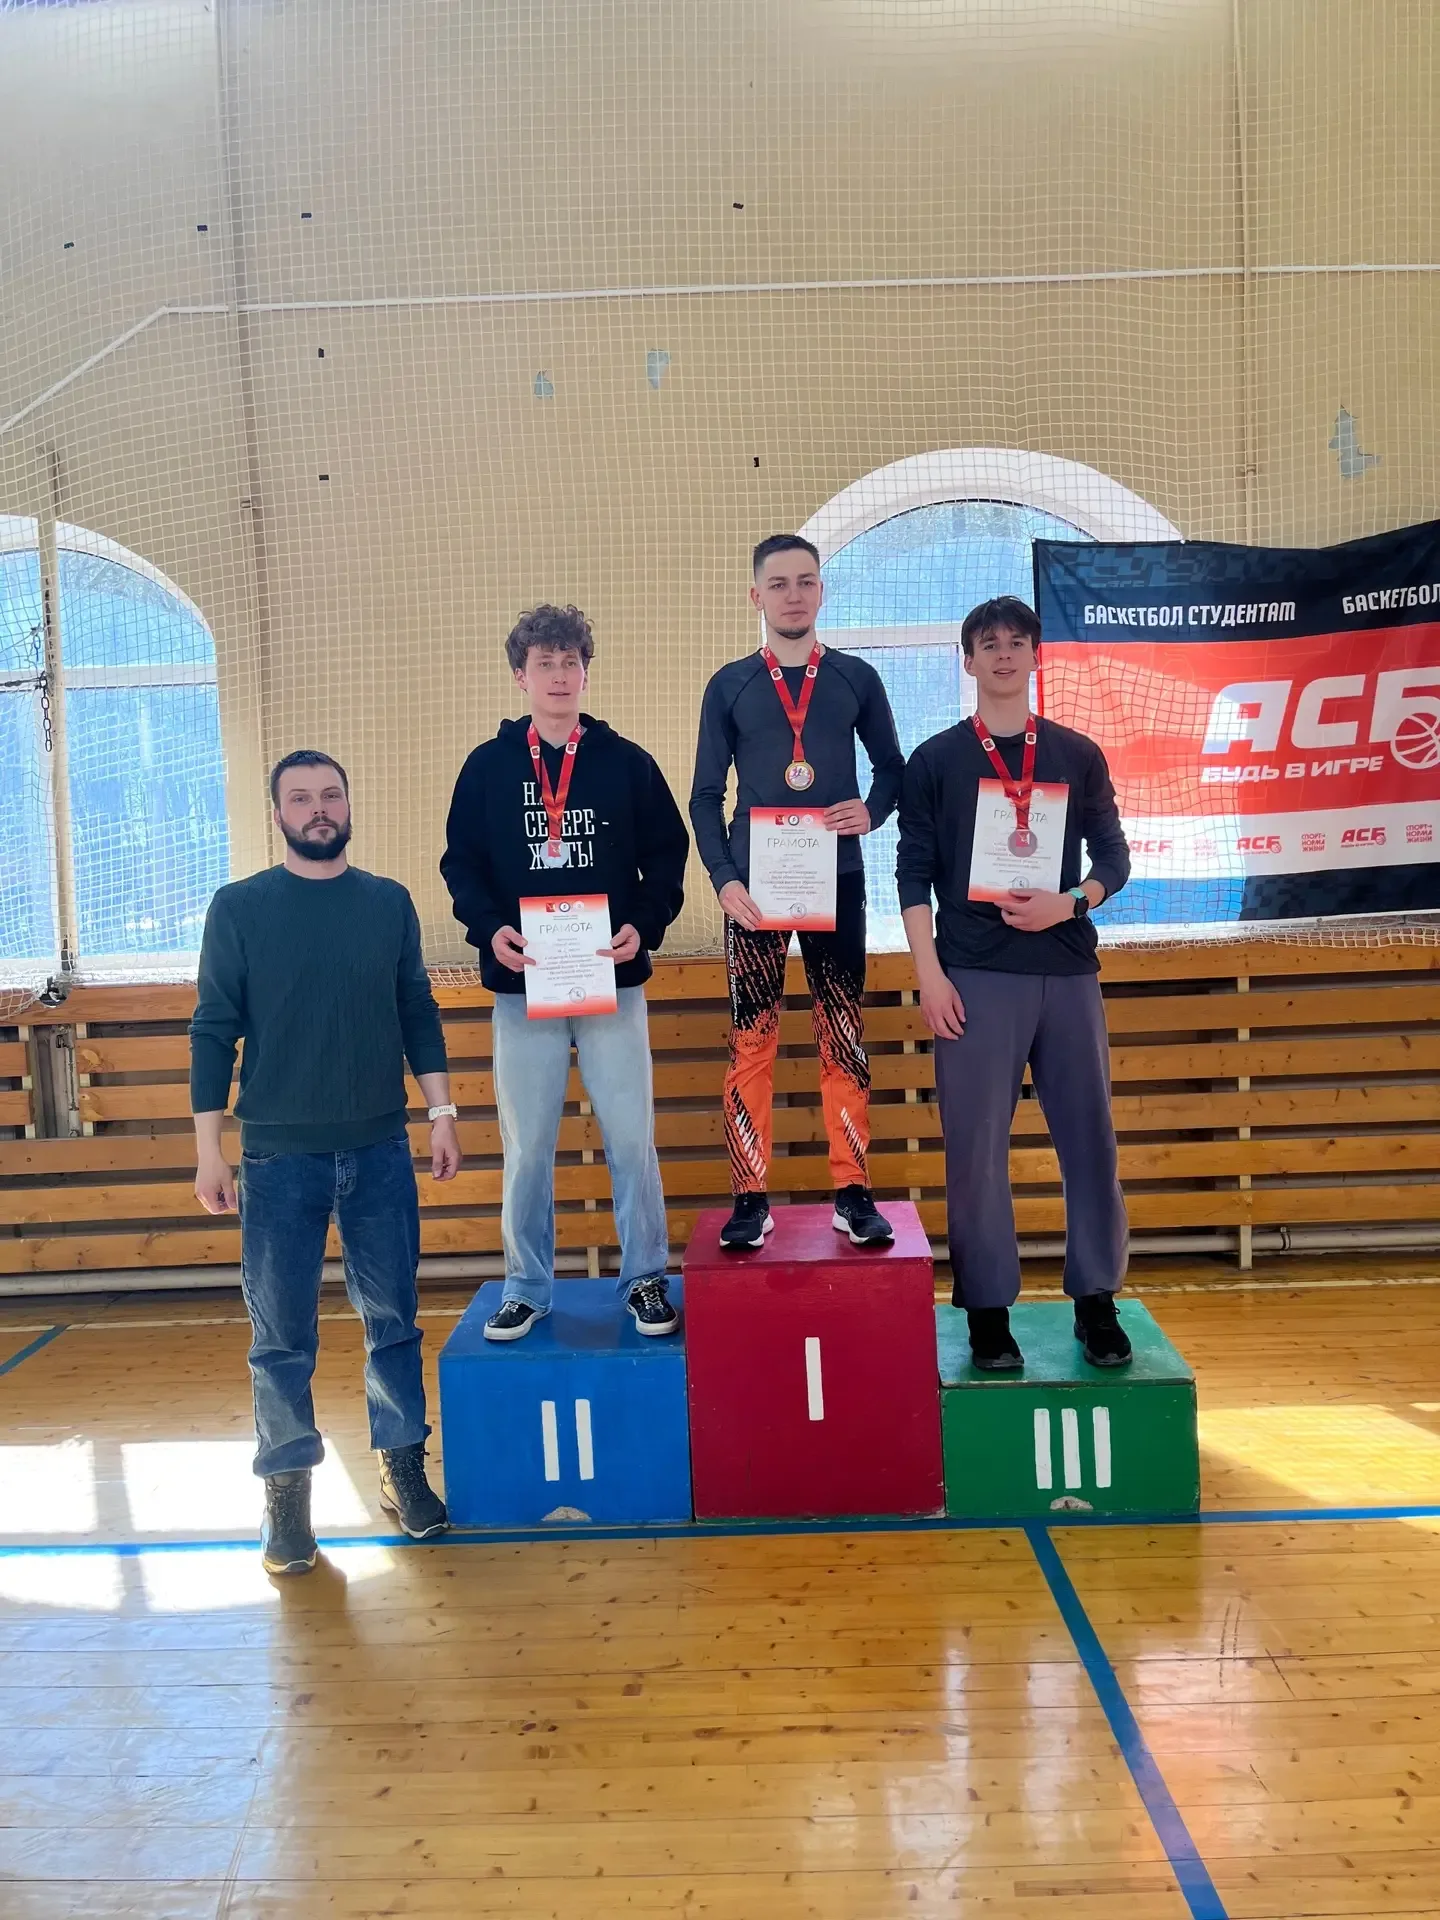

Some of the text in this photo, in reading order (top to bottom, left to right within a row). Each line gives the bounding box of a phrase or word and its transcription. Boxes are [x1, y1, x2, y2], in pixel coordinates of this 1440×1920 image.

[1342, 583, 1440, 615] БАСКЕТБОЛ
[1084, 601, 1296, 627] БАСКЕТБОЛ СТУДЕНТАМ
[1202, 666, 1440, 769] АСБ
[1201, 755, 1384, 784] БУДЬ В ИГРЕ
[522, 781, 544, 806] Н
[524, 808, 595, 838] СЕЕРЕ
[1341, 826, 1386, 845] АСБ
[527, 840, 594, 870] ЖТЬ!
[767, 837, 820, 848] ГРАМОТА
